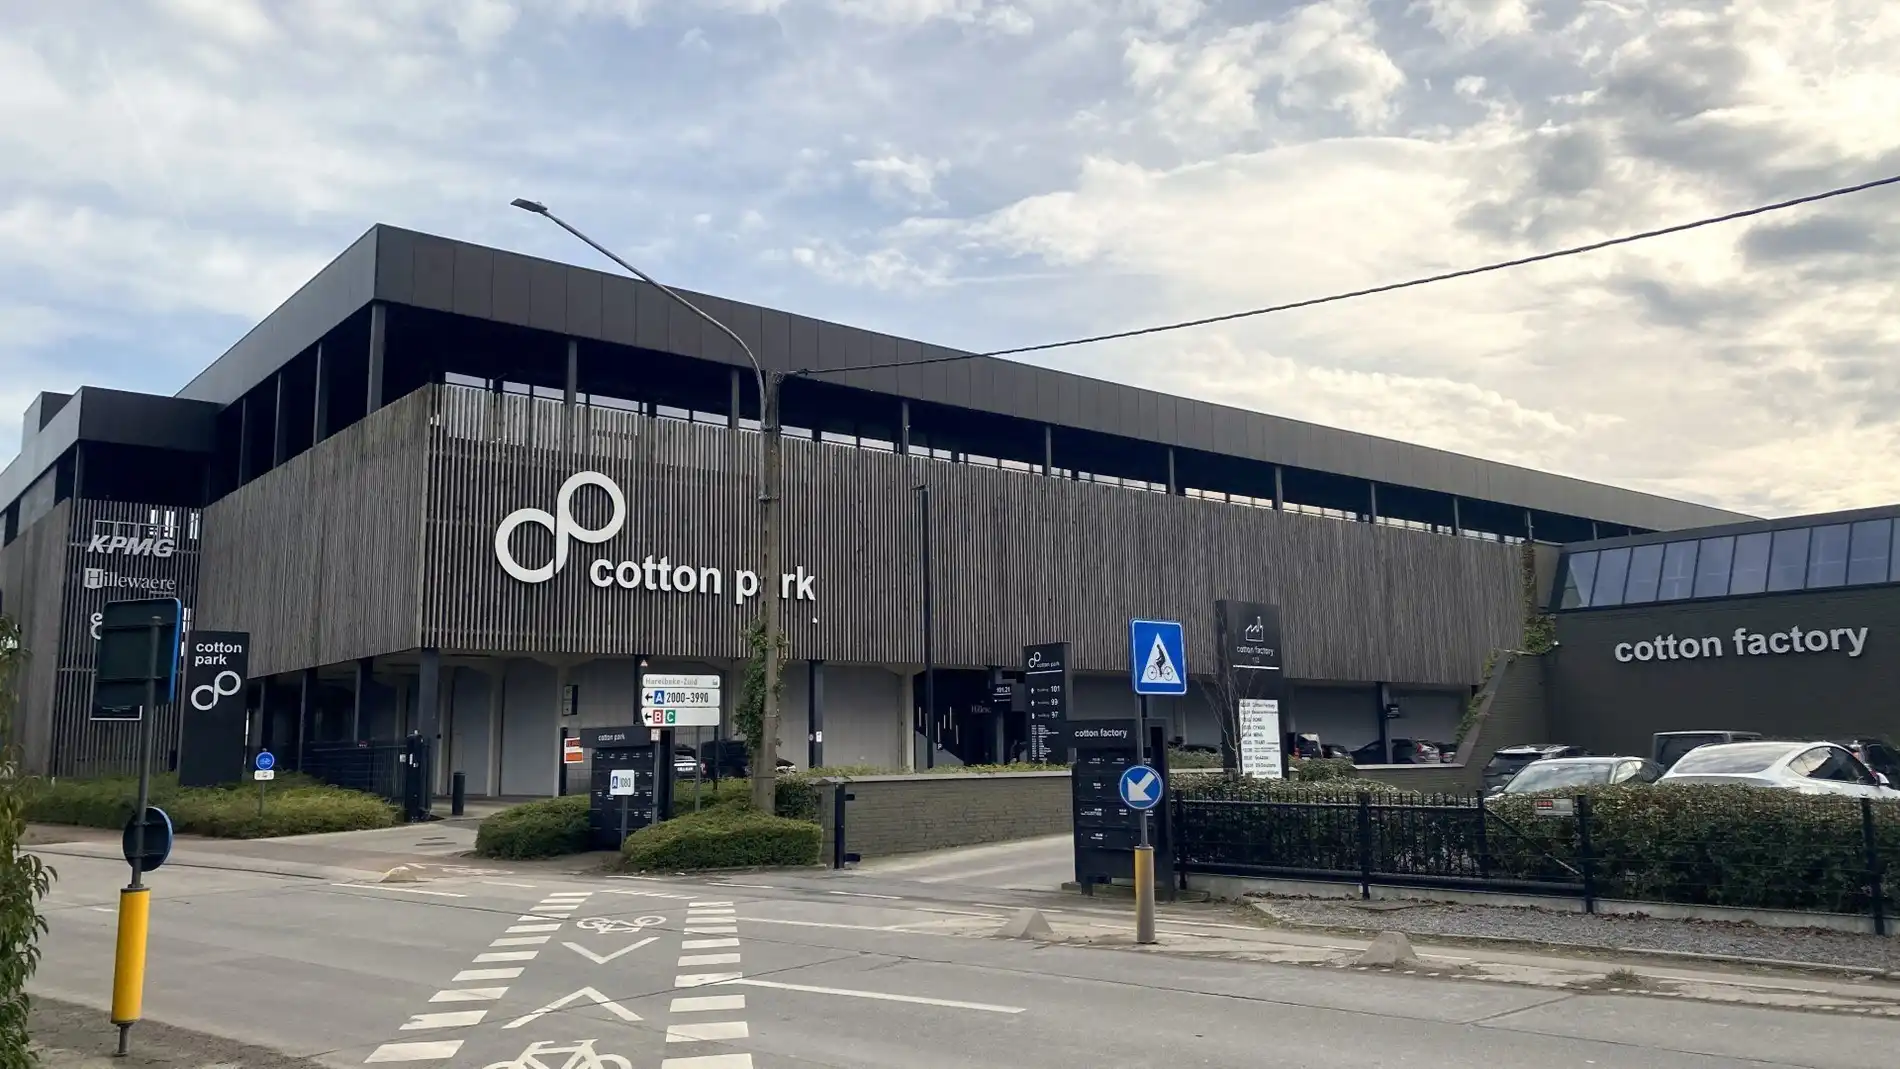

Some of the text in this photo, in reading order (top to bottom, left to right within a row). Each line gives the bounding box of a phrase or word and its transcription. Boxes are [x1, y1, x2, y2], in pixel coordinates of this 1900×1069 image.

[87, 534, 175, 558] KPMG
[84, 567, 176, 590] Hillewaere
[589, 554, 816, 605] cotton prk
[194, 641, 242, 667] cotton park
[1614, 624, 1868, 663] cotton factory
[655, 691, 709, 703] A 2000-3990
[654, 711, 674, 722] B C
[613, 733, 625, 742] park
[1074, 728, 1127, 739] cotton factory
